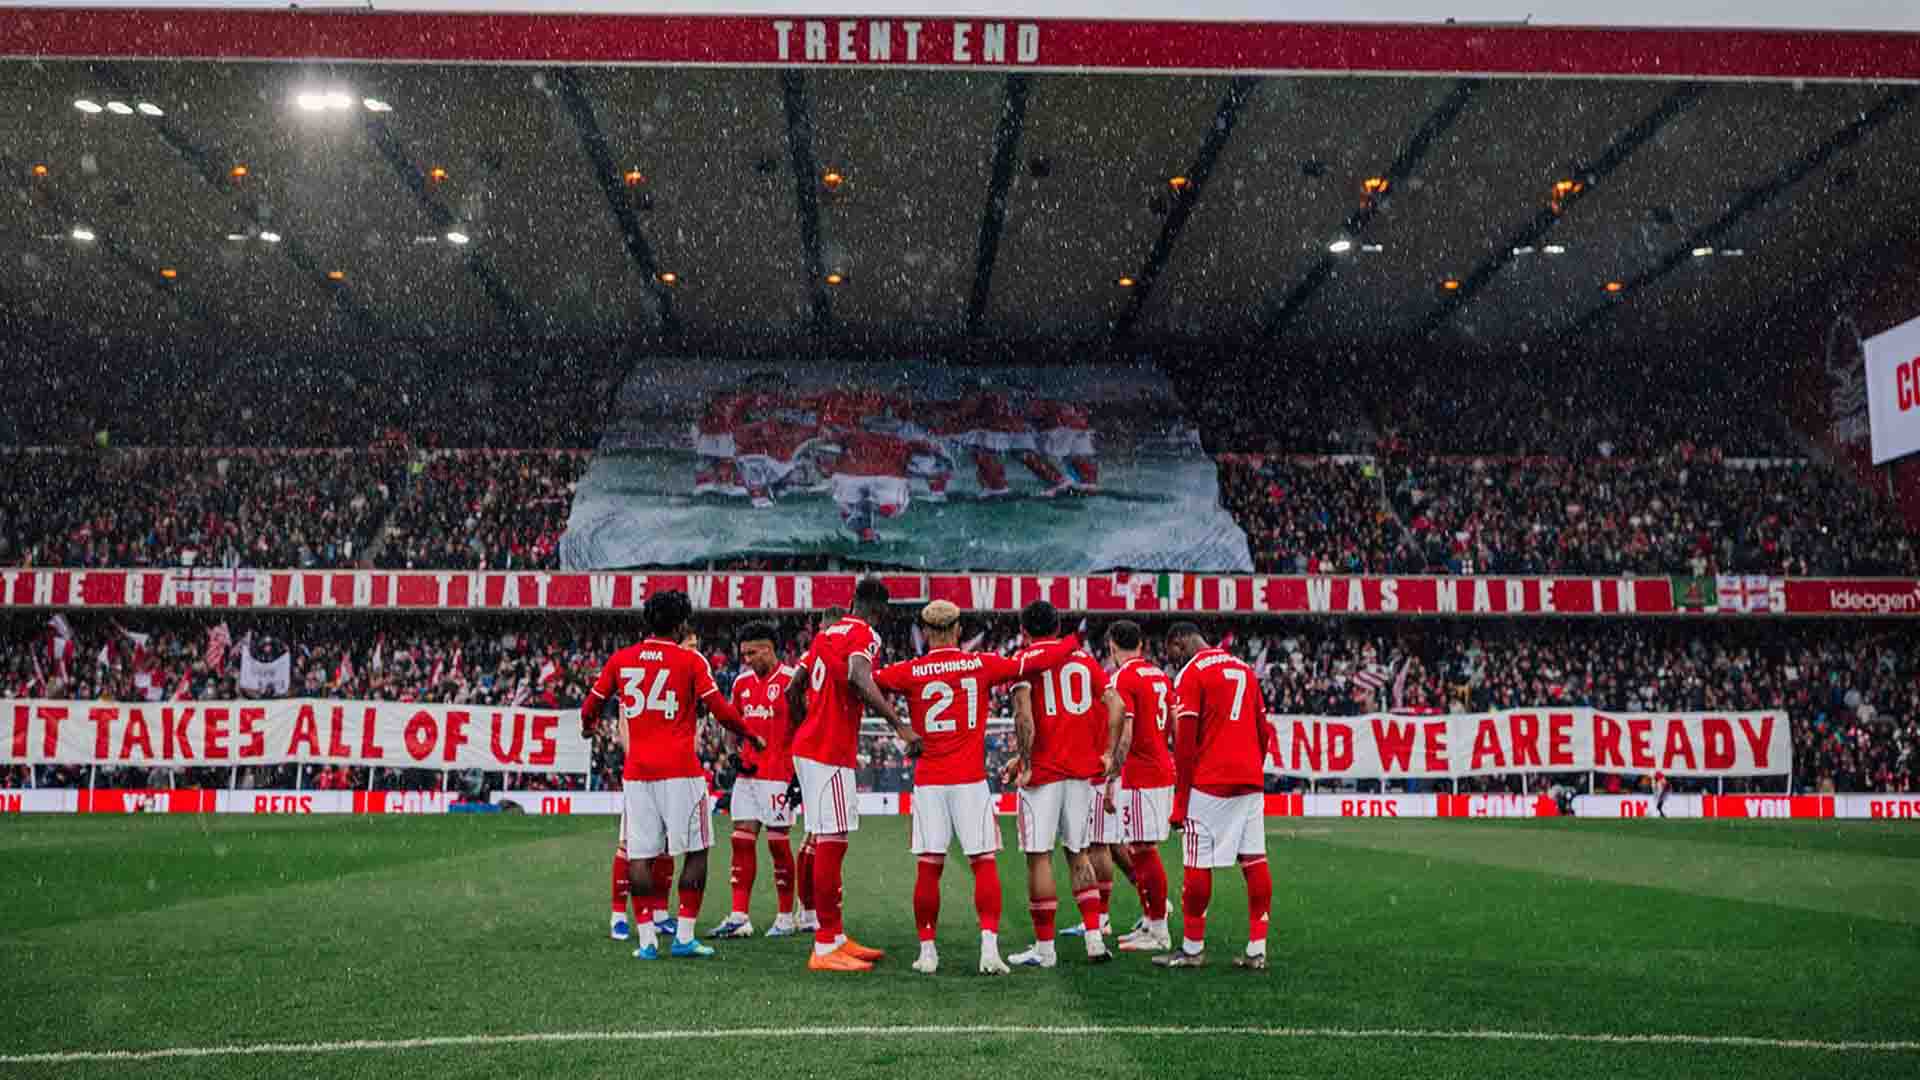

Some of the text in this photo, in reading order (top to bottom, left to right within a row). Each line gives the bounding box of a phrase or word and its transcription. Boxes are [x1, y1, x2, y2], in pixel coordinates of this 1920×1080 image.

[773, 20, 1039, 62] TRENT END
[1, 572, 86, 605] THE
[125, 573, 398, 607] GABALDI
[436, 574, 550, 607] THAT
[590, 575, 648, 608] WE
[687, 575, 814, 608] WEAR
[970, 577, 1088, 610] WITH
[1306, 578, 1398, 612] WAS
[1437, 578, 1555, 612] MADE
[1592, 578, 1636, 613] IN
[1830, 589, 1915, 613] Ideagen
[912, 656, 983, 677] HUTCHINSON
[1042, 662, 1092, 717] 10
[620, 667, 679, 719] 34
[921, 677, 978, 733] 21
[1152, 681, 1168, 730] 3
[1222, 668, 1247, 720] 7
[11, 704, 560, 765] IT TAKES ALL OF US
[1264, 713, 1775, 773] AND WE ARE READY
[1123, 806, 1130, 824] 3
